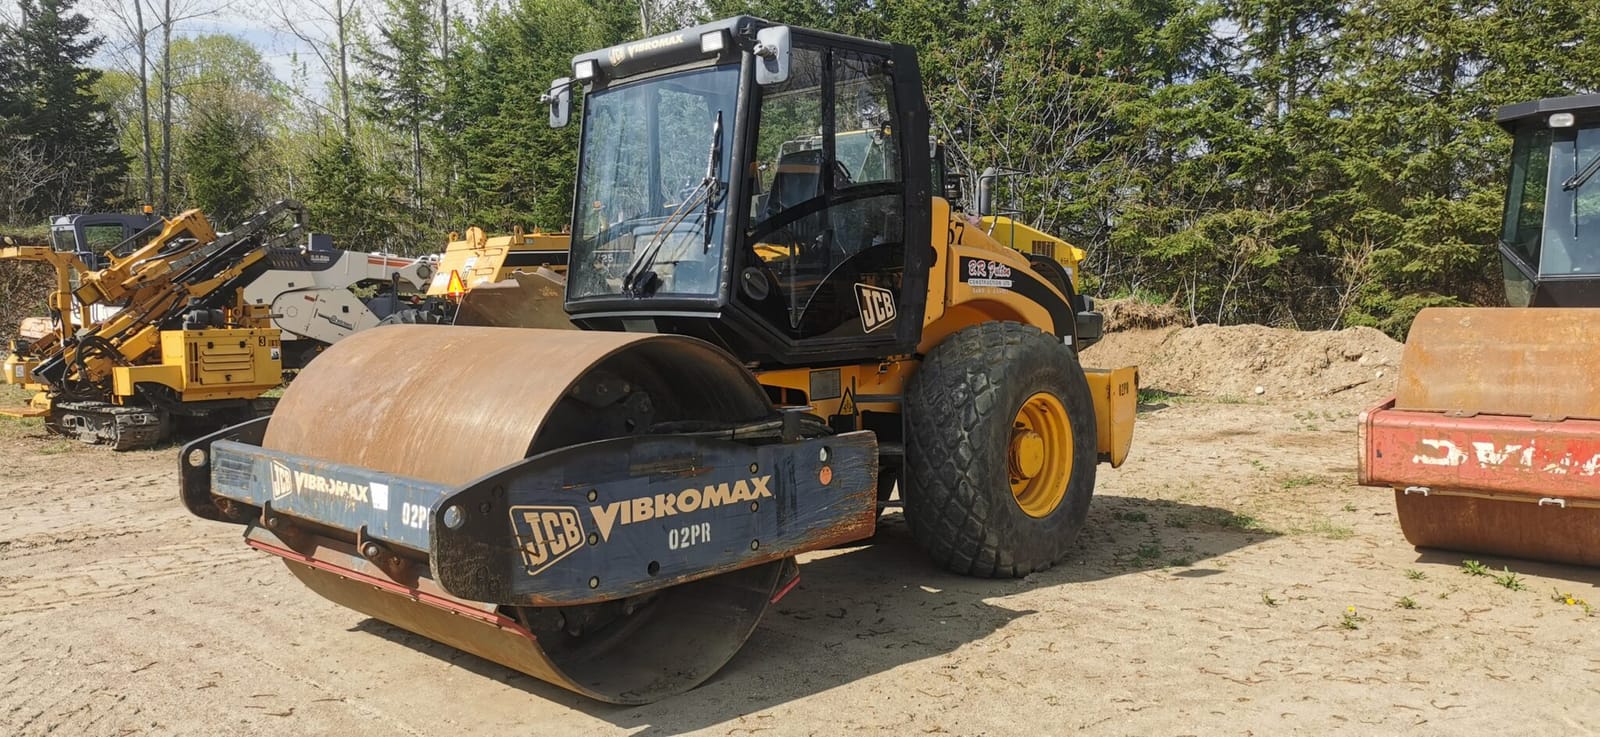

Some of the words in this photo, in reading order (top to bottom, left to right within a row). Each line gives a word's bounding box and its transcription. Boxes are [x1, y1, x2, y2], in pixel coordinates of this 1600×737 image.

[627, 34, 684, 58] VIBROMAX
[860, 286, 895, 330] JCB
[272, 463, 292, 496] JCB
[402, 502, 431, 531] 02P
[522, 509, 583, 568] JCB
[590, 475, 773, 543] VIBROMAX
[668, 521, 712, 550] 02PR
